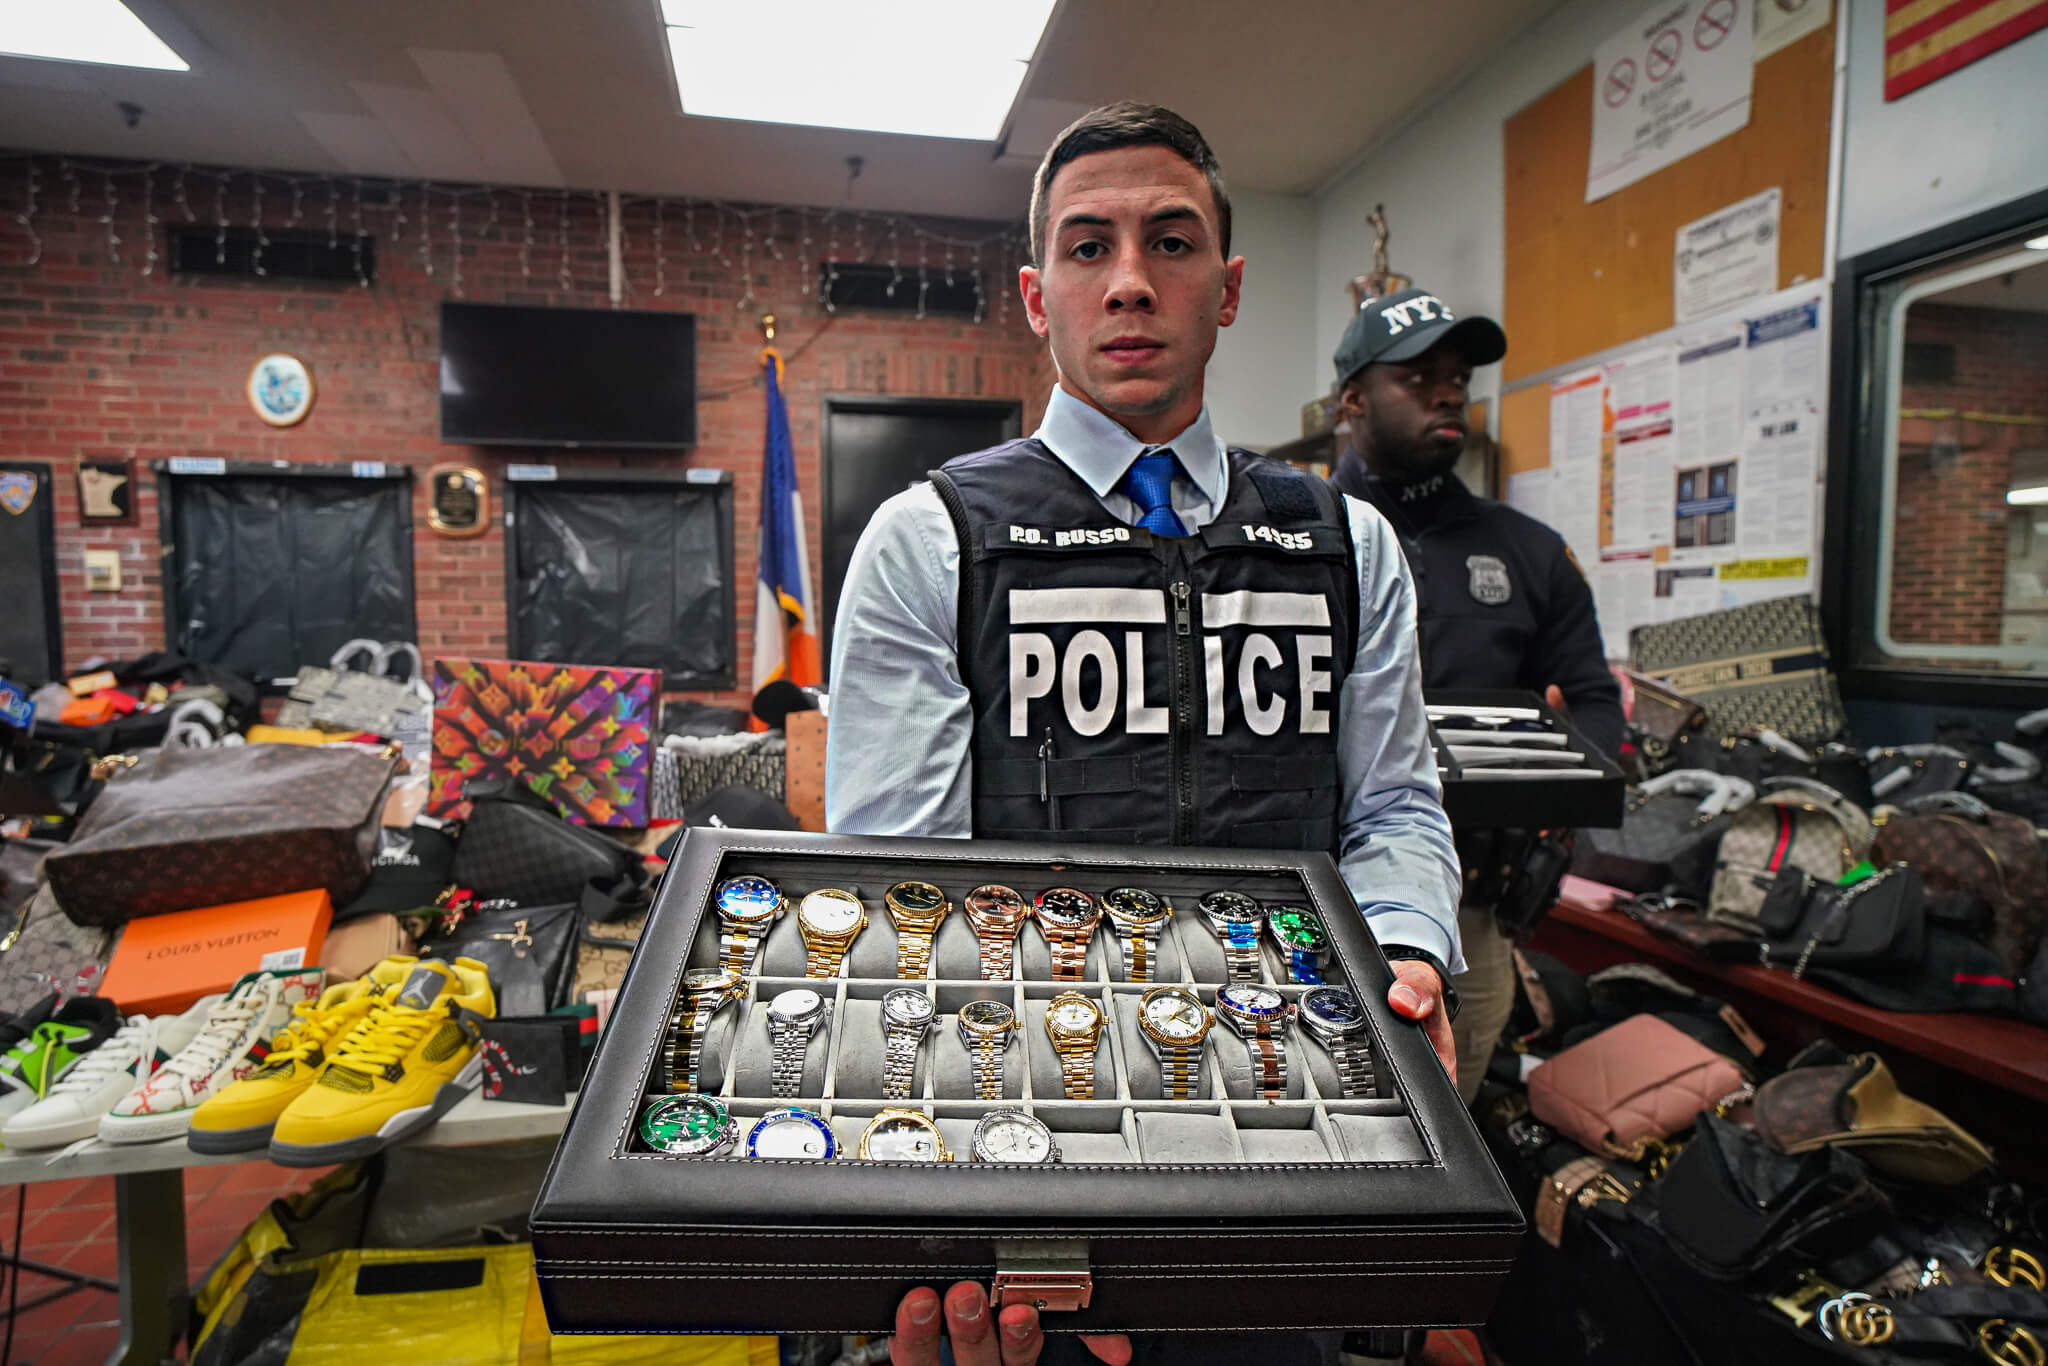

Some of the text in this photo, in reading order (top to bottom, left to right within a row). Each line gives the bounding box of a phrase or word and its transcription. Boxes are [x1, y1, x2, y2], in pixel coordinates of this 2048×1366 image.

[1009, 525, 1131, 547] P.O. RUSSO
[1009, 629, 1333, 737] POLICE
[146, 928, 281, 960] LOUIS VUITTON
